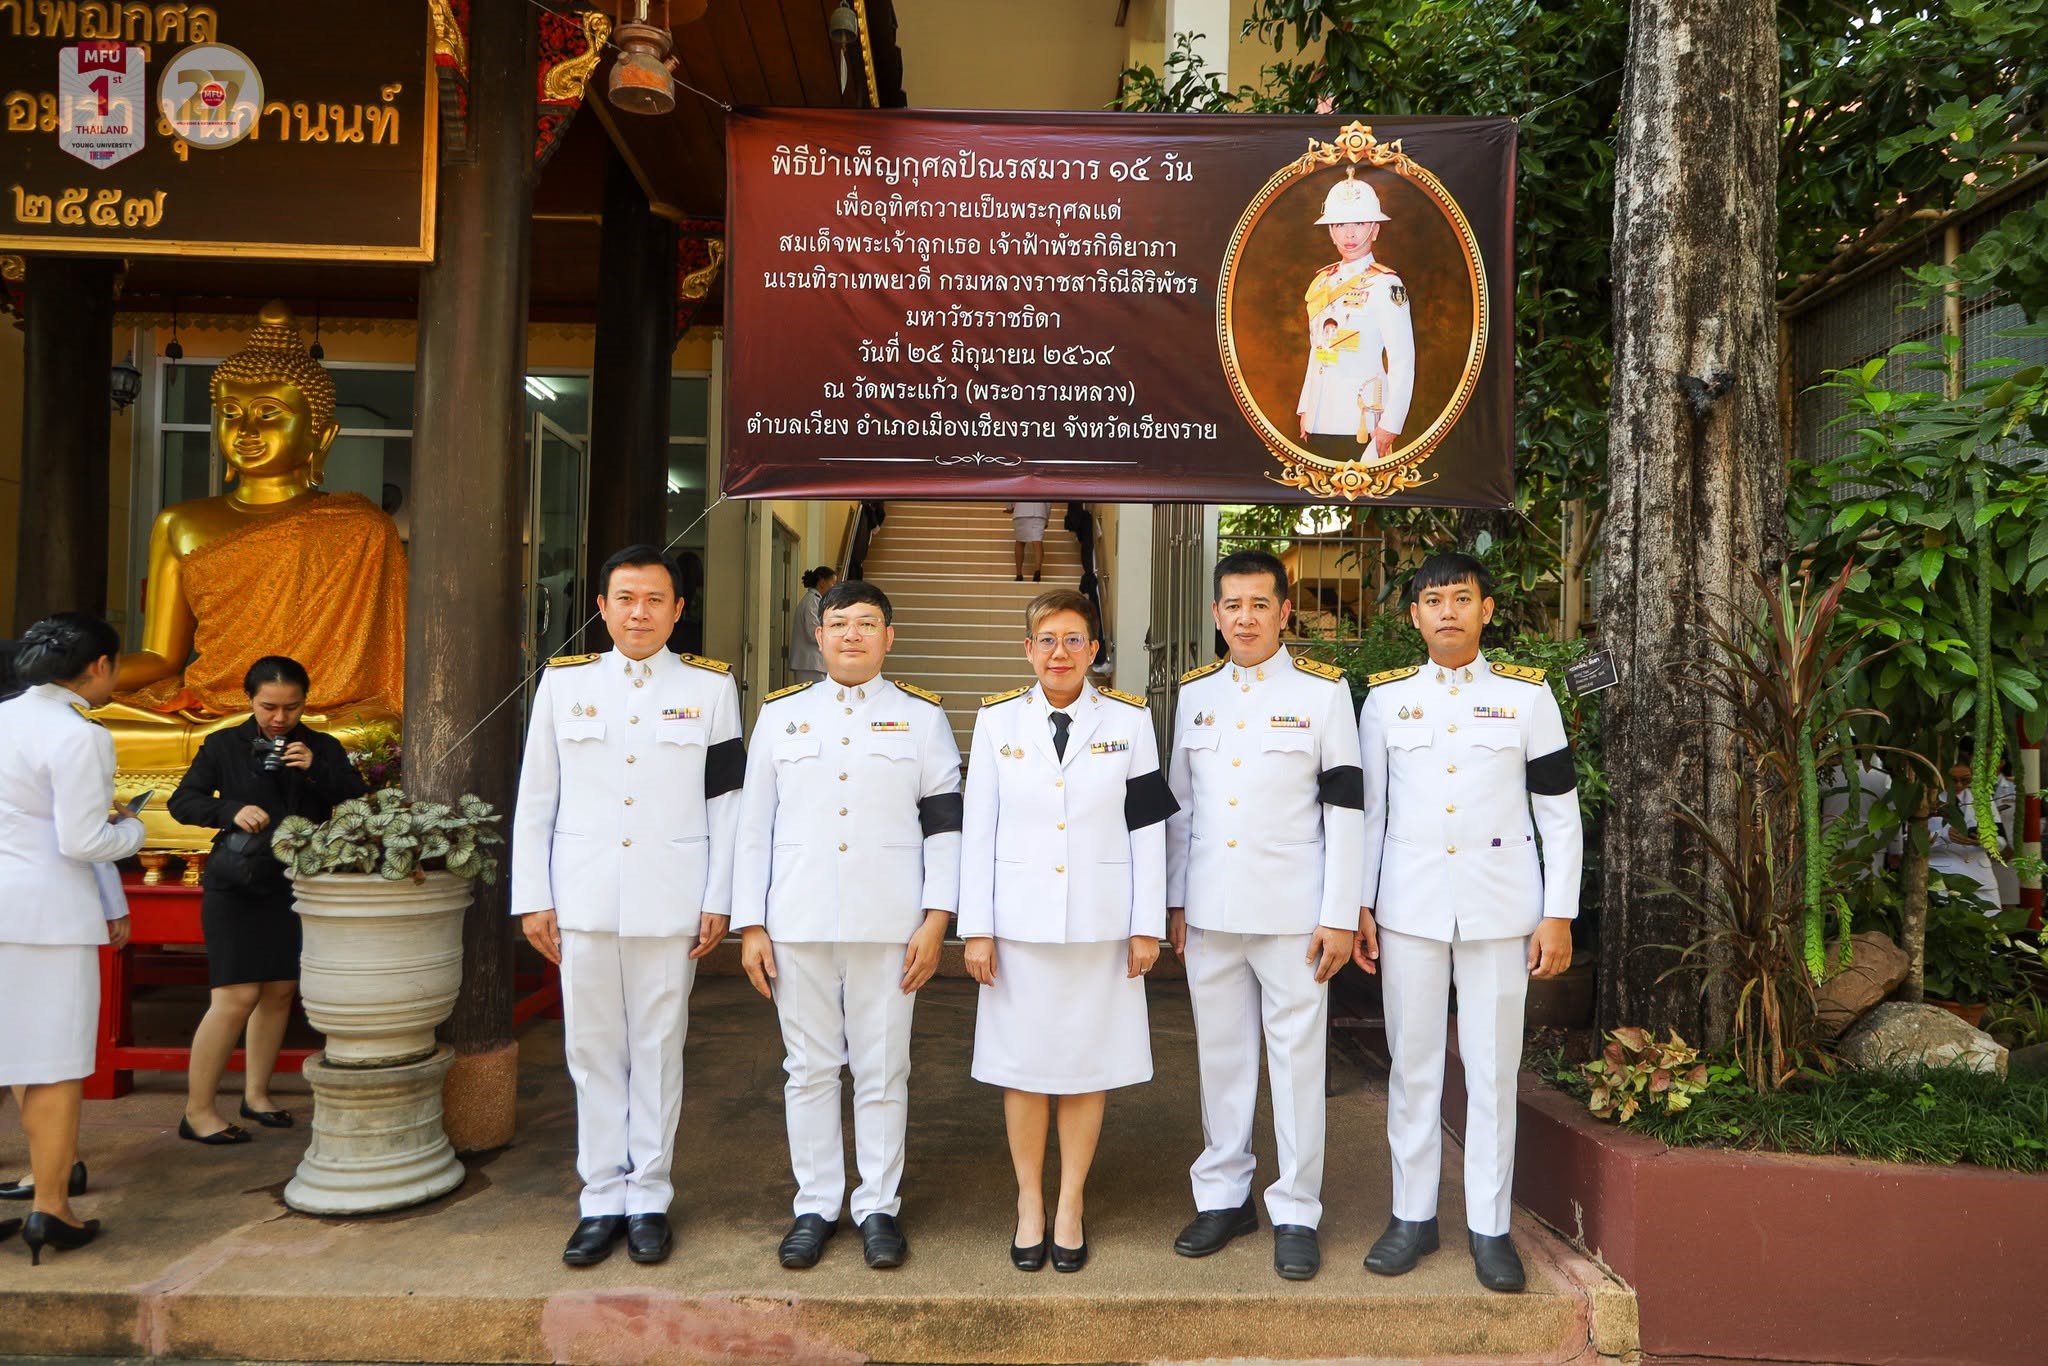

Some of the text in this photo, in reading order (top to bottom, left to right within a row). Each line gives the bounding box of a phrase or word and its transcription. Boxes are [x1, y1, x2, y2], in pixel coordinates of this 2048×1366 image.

[771, 144, 1194, 185] พิธีบำเพ็ญกุศลปัณรสมวาร ๑๕ วัน
[12, 186, 167, 228] ๒๕๕๗
[835, 186, 1122, 227] เพื่ออุทิศถวายเป็นพระกุศลแด่
[779, 227, 1177, 262] สมเด็จพระเจ้าลูกเธอ เจ้าฟ้าพัชรกิติยาภา
[763, 264, 1198, 294] นเรนทิราเทพยวดี กรมหลวงราชสาริณีสิริพัชร
[905, 303, 1061, 329] มหาวัชรราชธิดา
[858, 331, 1115, 372] วันที่ ๒๕ มิถุนายน ๒๕๖๙
[823, 375, 1135, 406] ณ วัดพระแก้ว (พระอารามหลวง)
[747, 409, 1217, 440] ตำบลเวียง อำเภอเมืองเชียงราย จังหวัดเชียงราย
